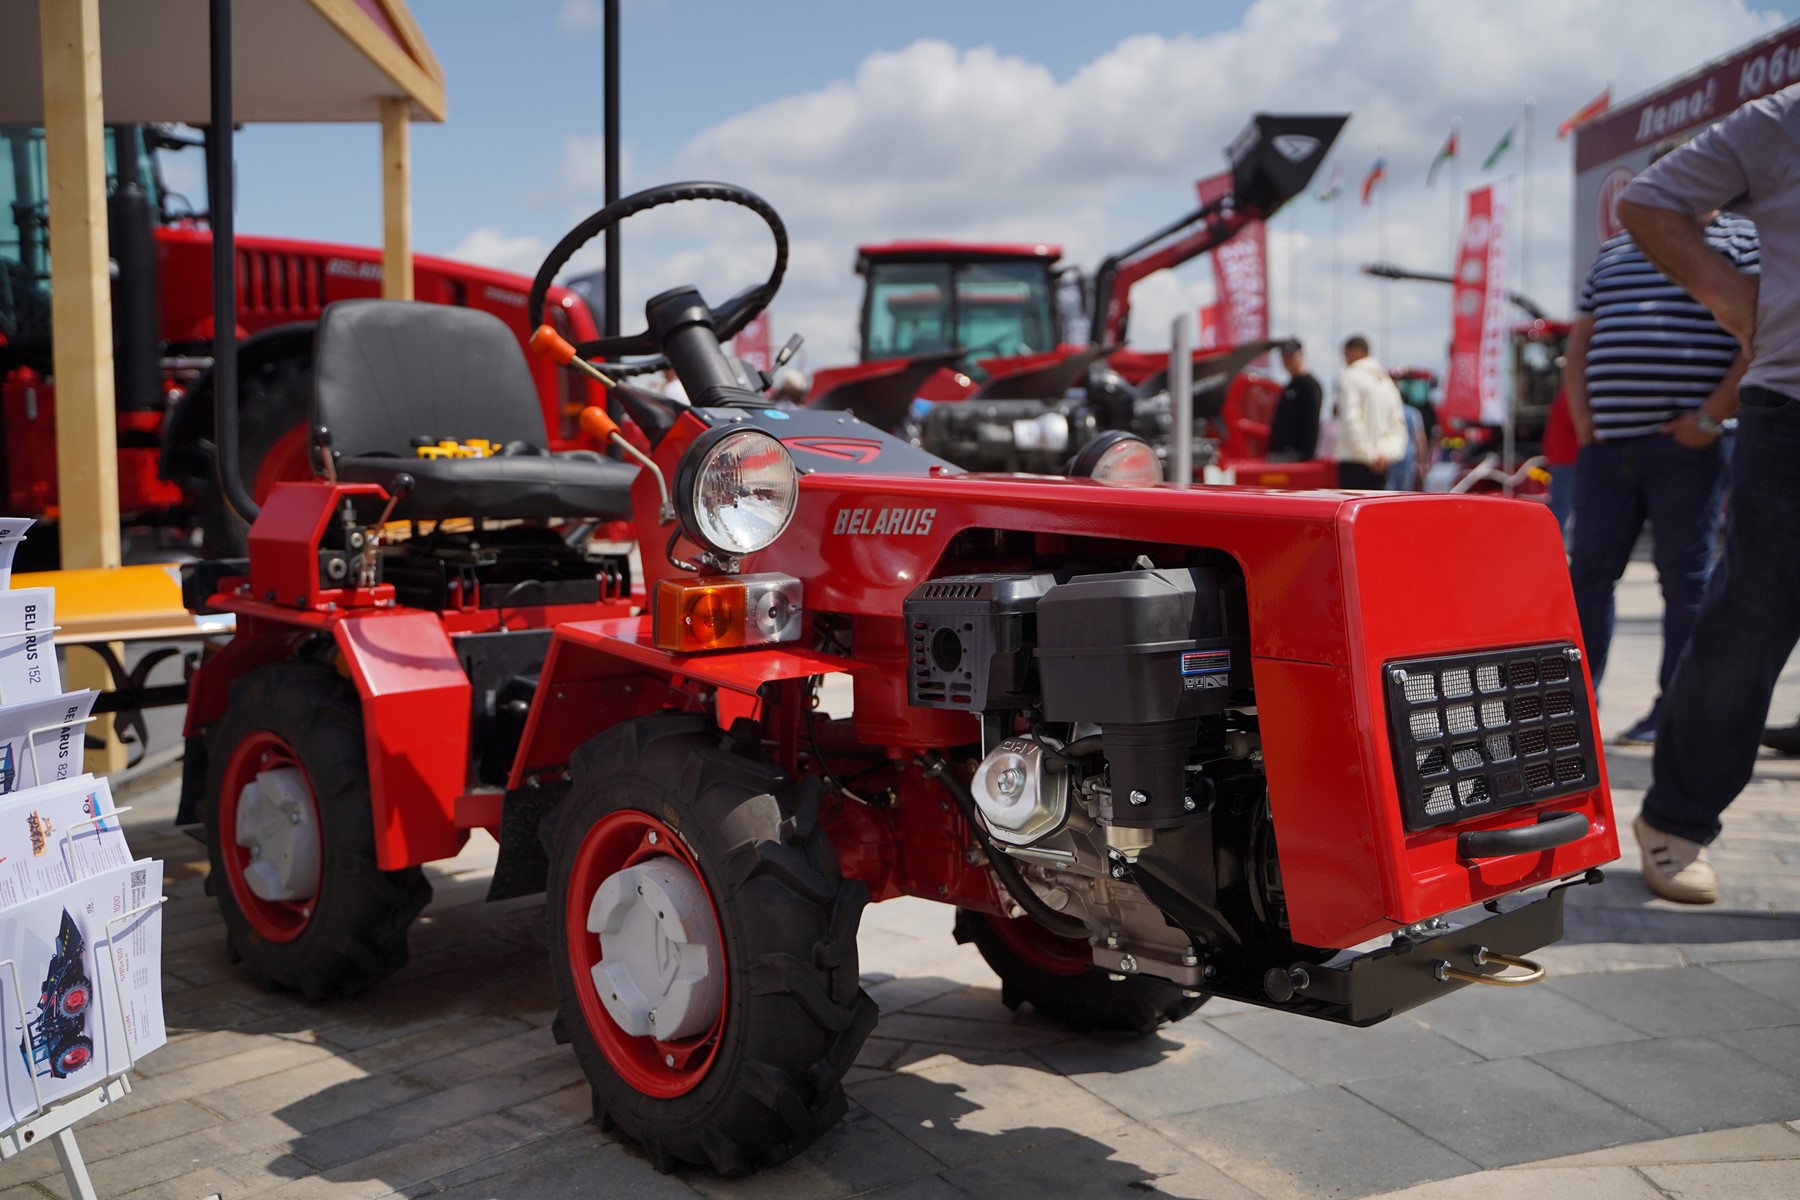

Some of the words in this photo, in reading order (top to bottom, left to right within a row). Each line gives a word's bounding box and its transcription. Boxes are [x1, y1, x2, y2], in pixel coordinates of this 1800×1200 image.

[1635, 77, 1717, 142] Лето!
[833, 508, 937, 535] BELARUS
[29, 665, 41, 684] 152
[57, 763, 68, 781] 82
[113, 895, 121, 913] 1000
